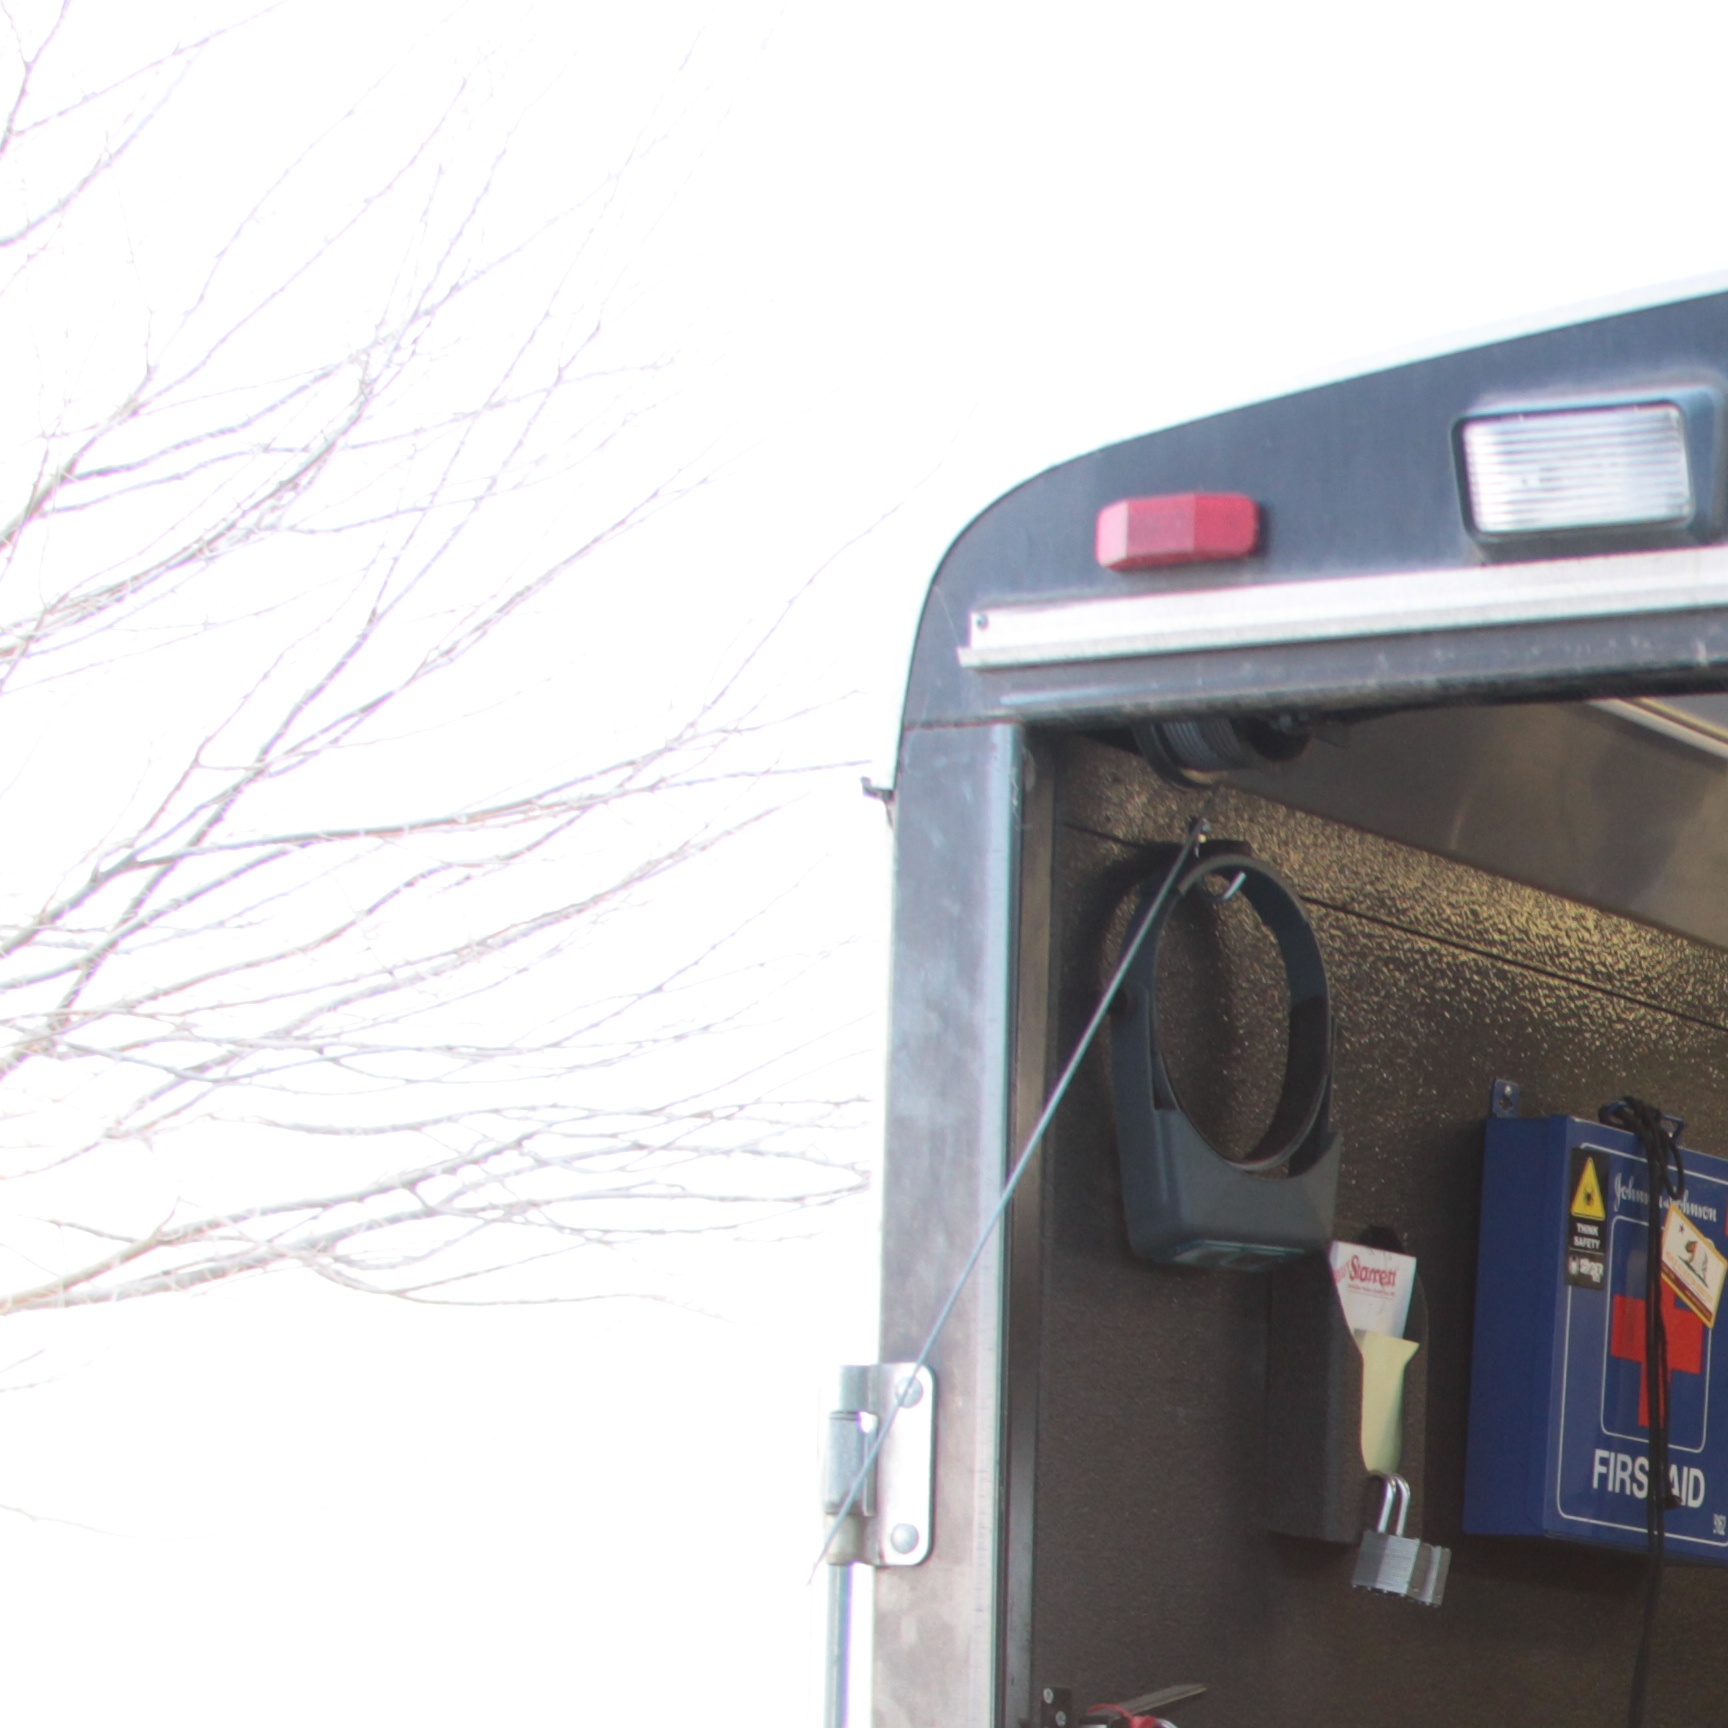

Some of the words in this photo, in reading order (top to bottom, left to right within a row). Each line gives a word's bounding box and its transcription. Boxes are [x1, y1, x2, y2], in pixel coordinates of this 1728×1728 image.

[1574, 1235, 1601, 1249] SAFETY
[1593, 1448, 1650, 1499] FIRS
[1669, 1463, 1706, 1509] AID
